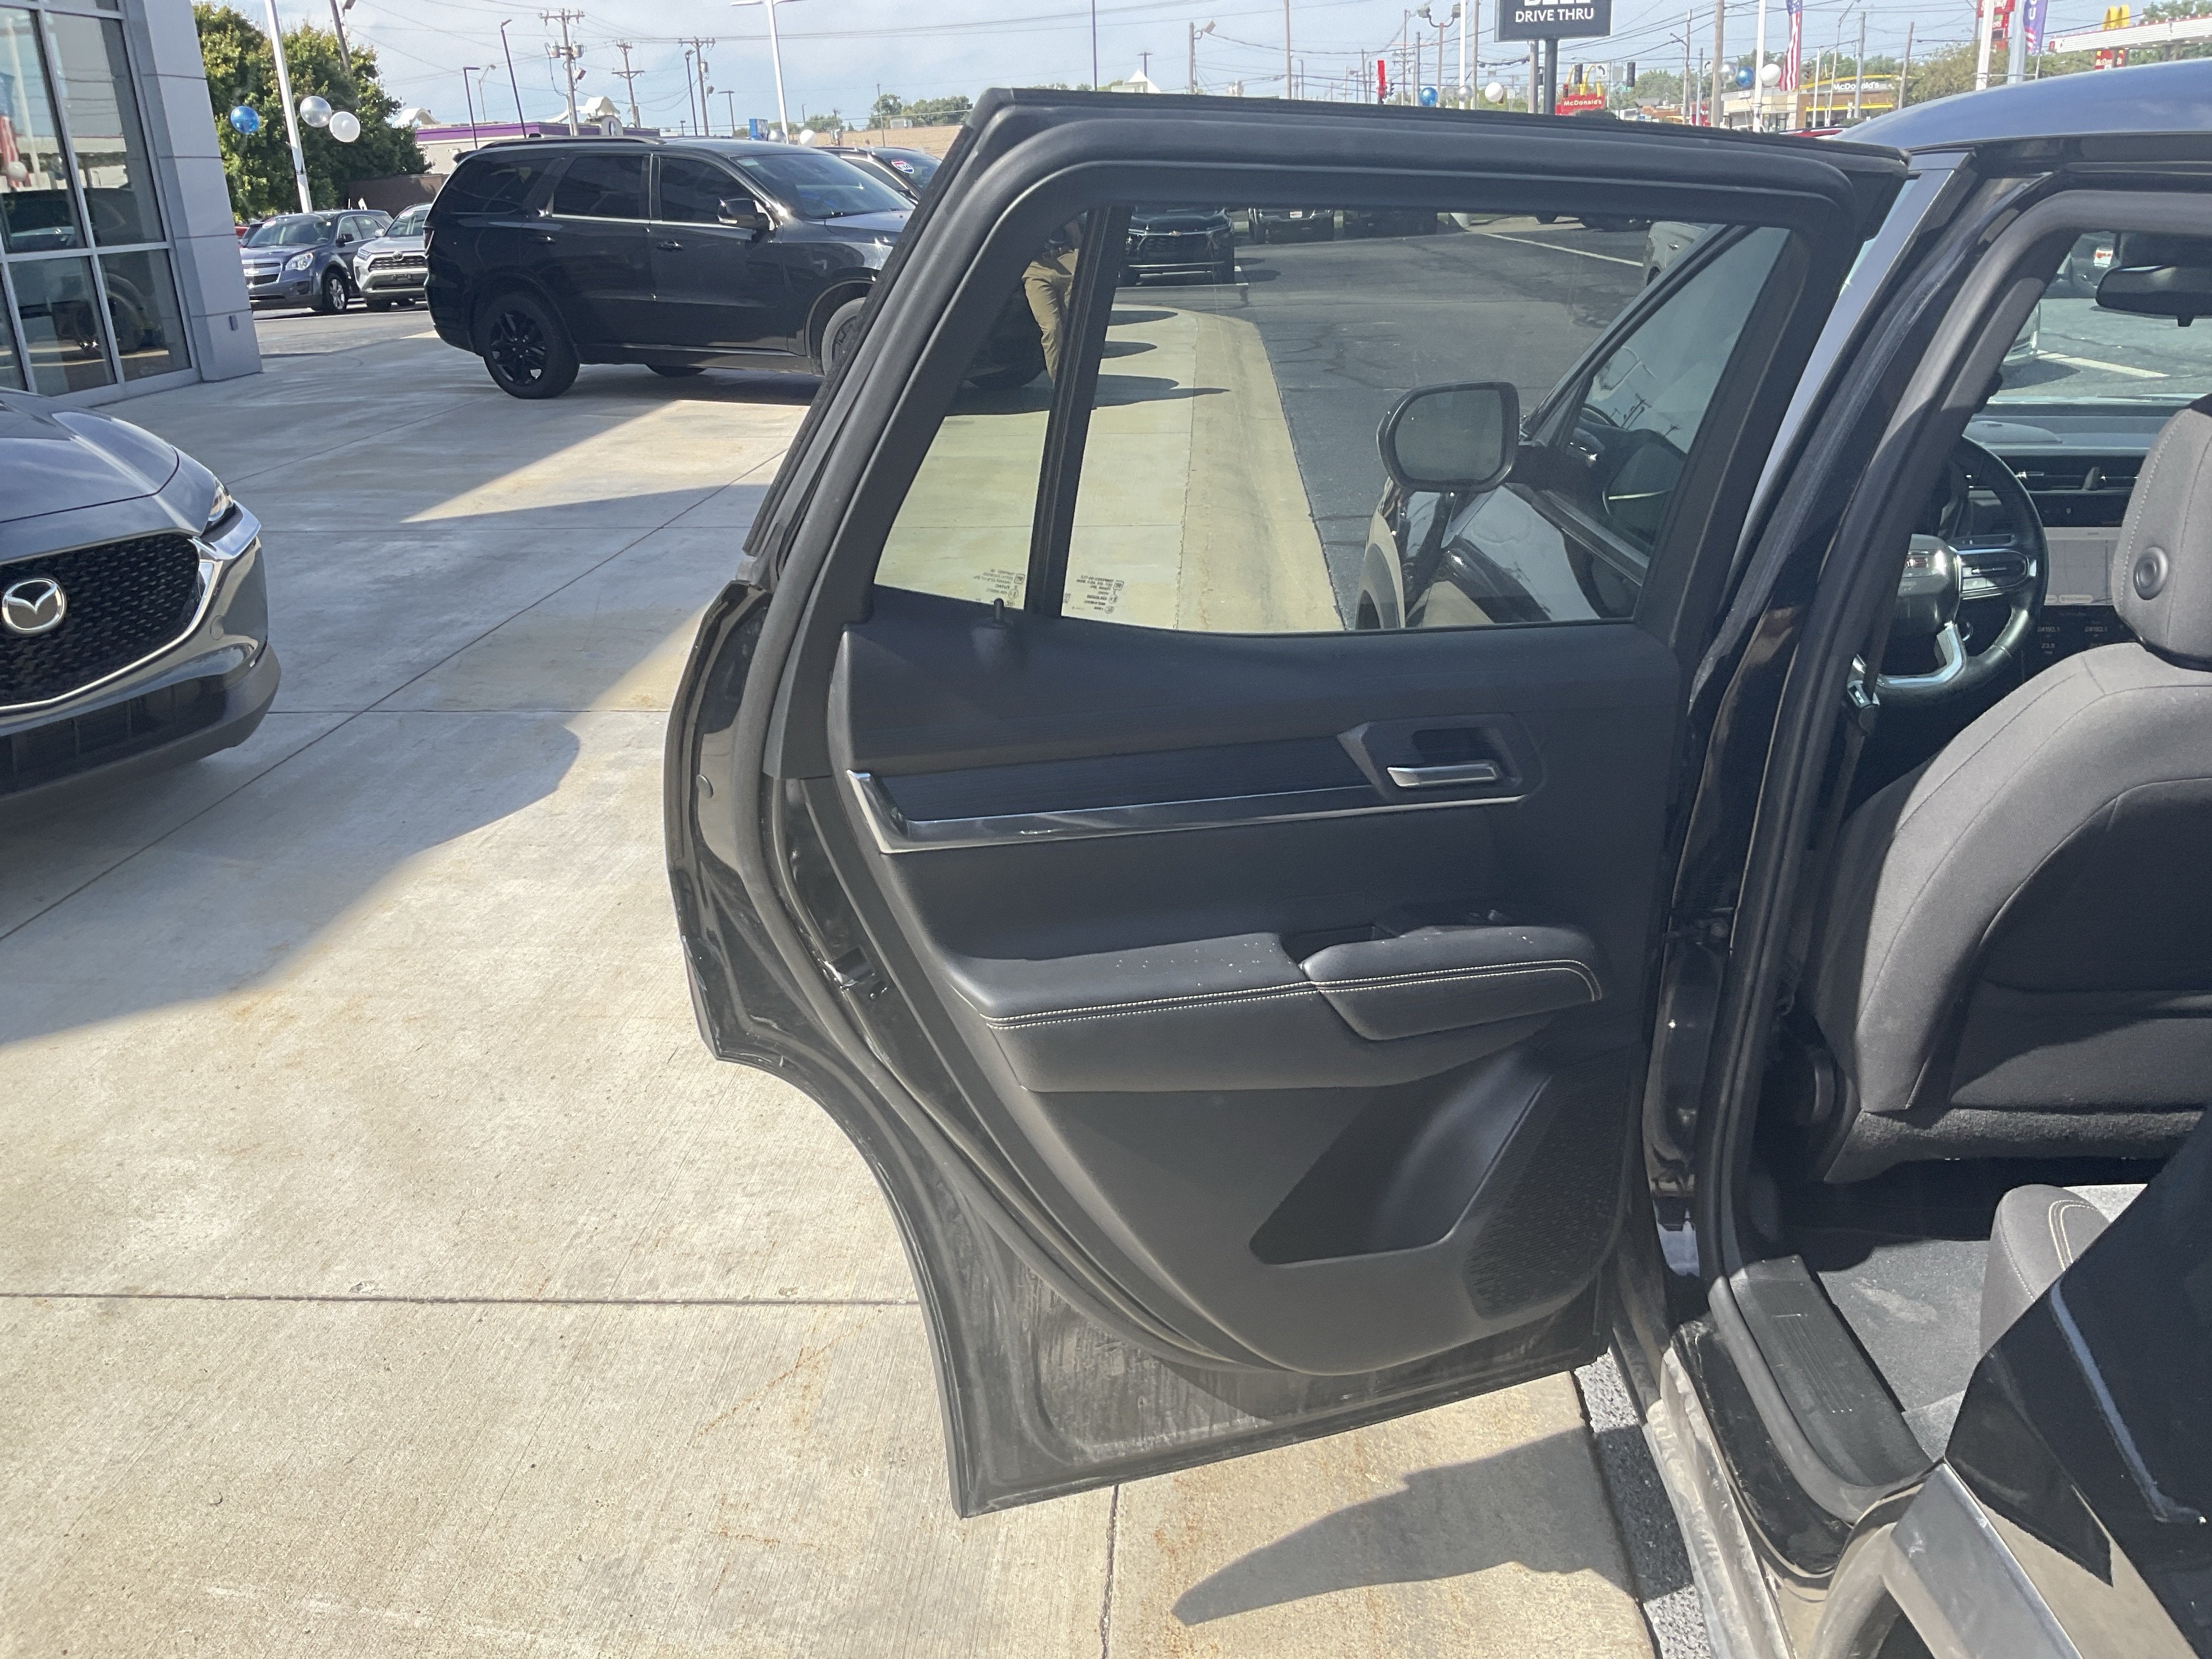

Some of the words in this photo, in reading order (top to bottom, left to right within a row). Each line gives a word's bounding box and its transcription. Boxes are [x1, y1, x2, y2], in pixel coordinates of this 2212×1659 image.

[1515, 9, 1554, 23] DRIVE
[1557, 8, 1594, 21] THRU
[1833, 81, 1880, 91] McDoald's
